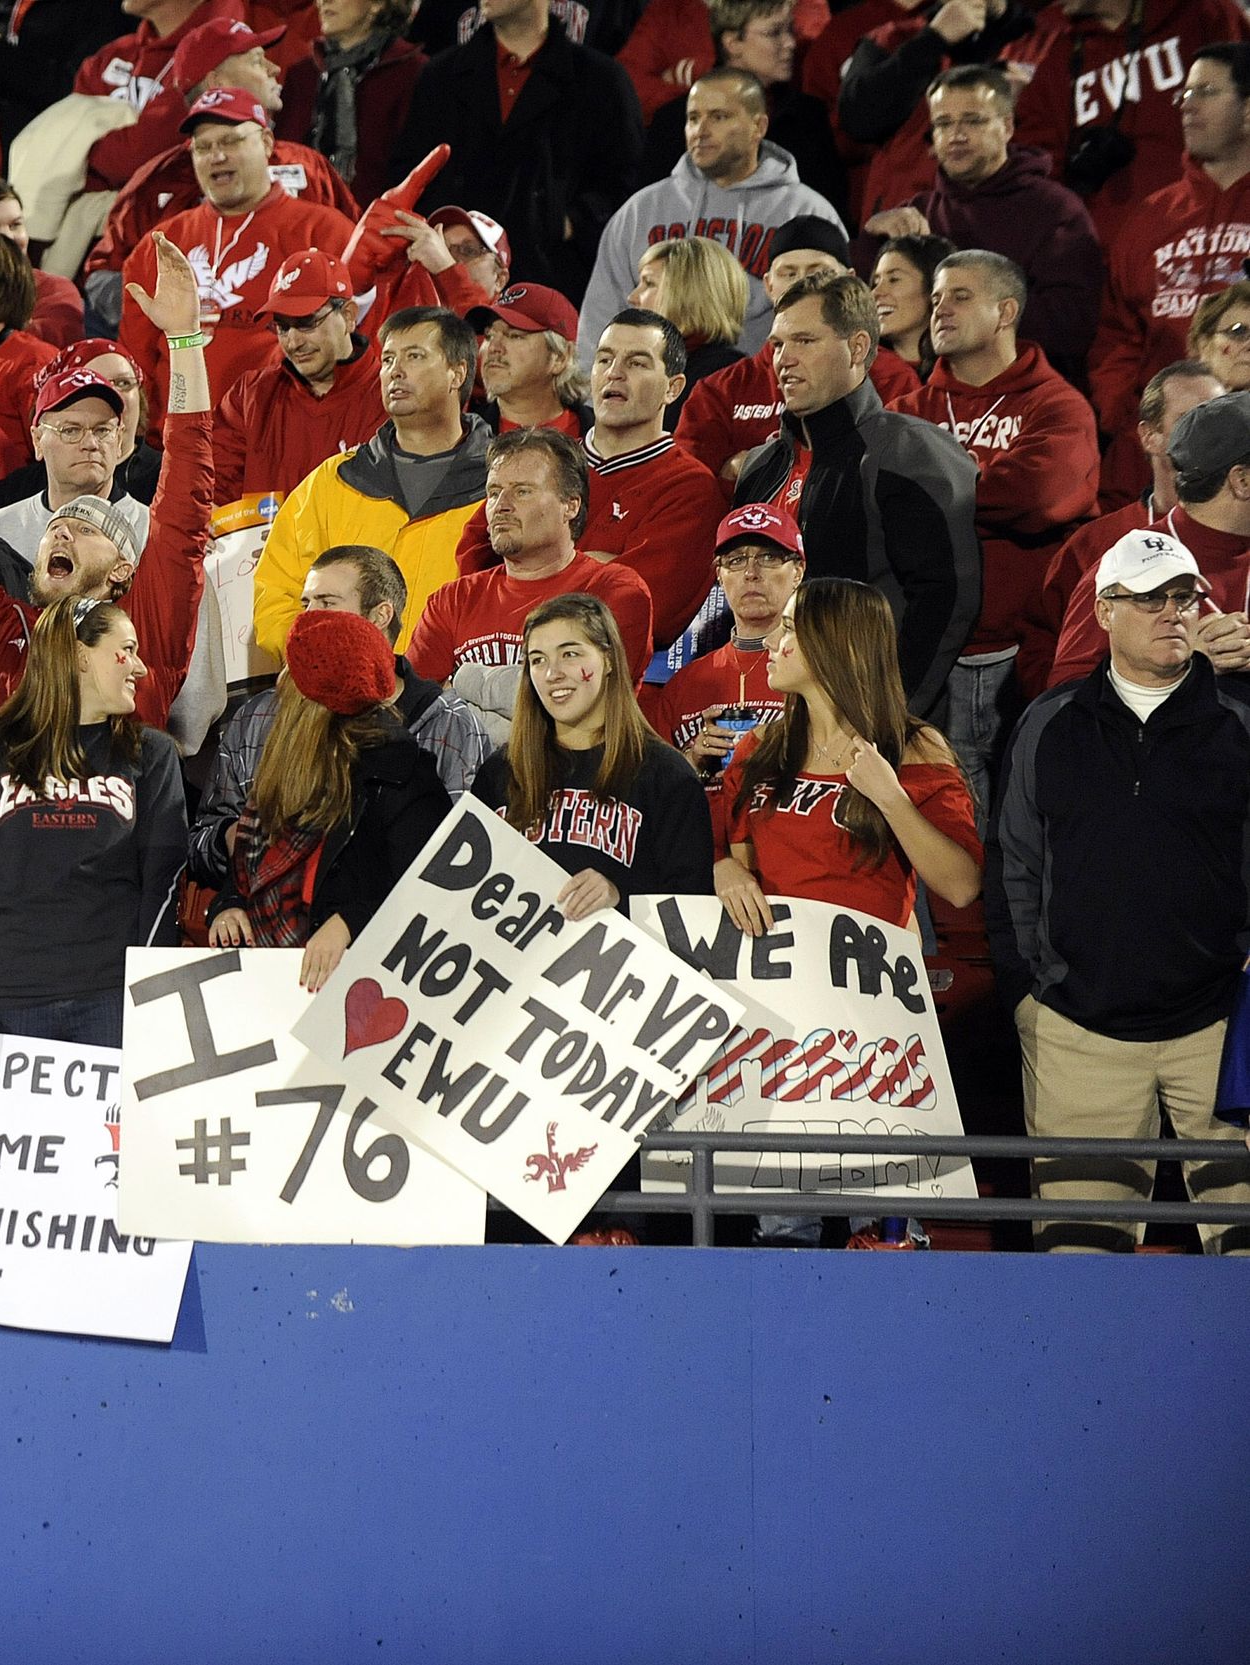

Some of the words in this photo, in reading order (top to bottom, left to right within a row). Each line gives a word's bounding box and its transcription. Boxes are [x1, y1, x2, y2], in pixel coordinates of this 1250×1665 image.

[1075, 36, 1184, 126] EWU
[32, 812, 98, 825] EASTERN
[419, 810, 565, 952] Dear
[381, 913, 513, 1026] NOT
[657, 896, 795, 980] WE
[129, 949, 278, 1102] I
[381, 1021, 531, 1145] EWU
